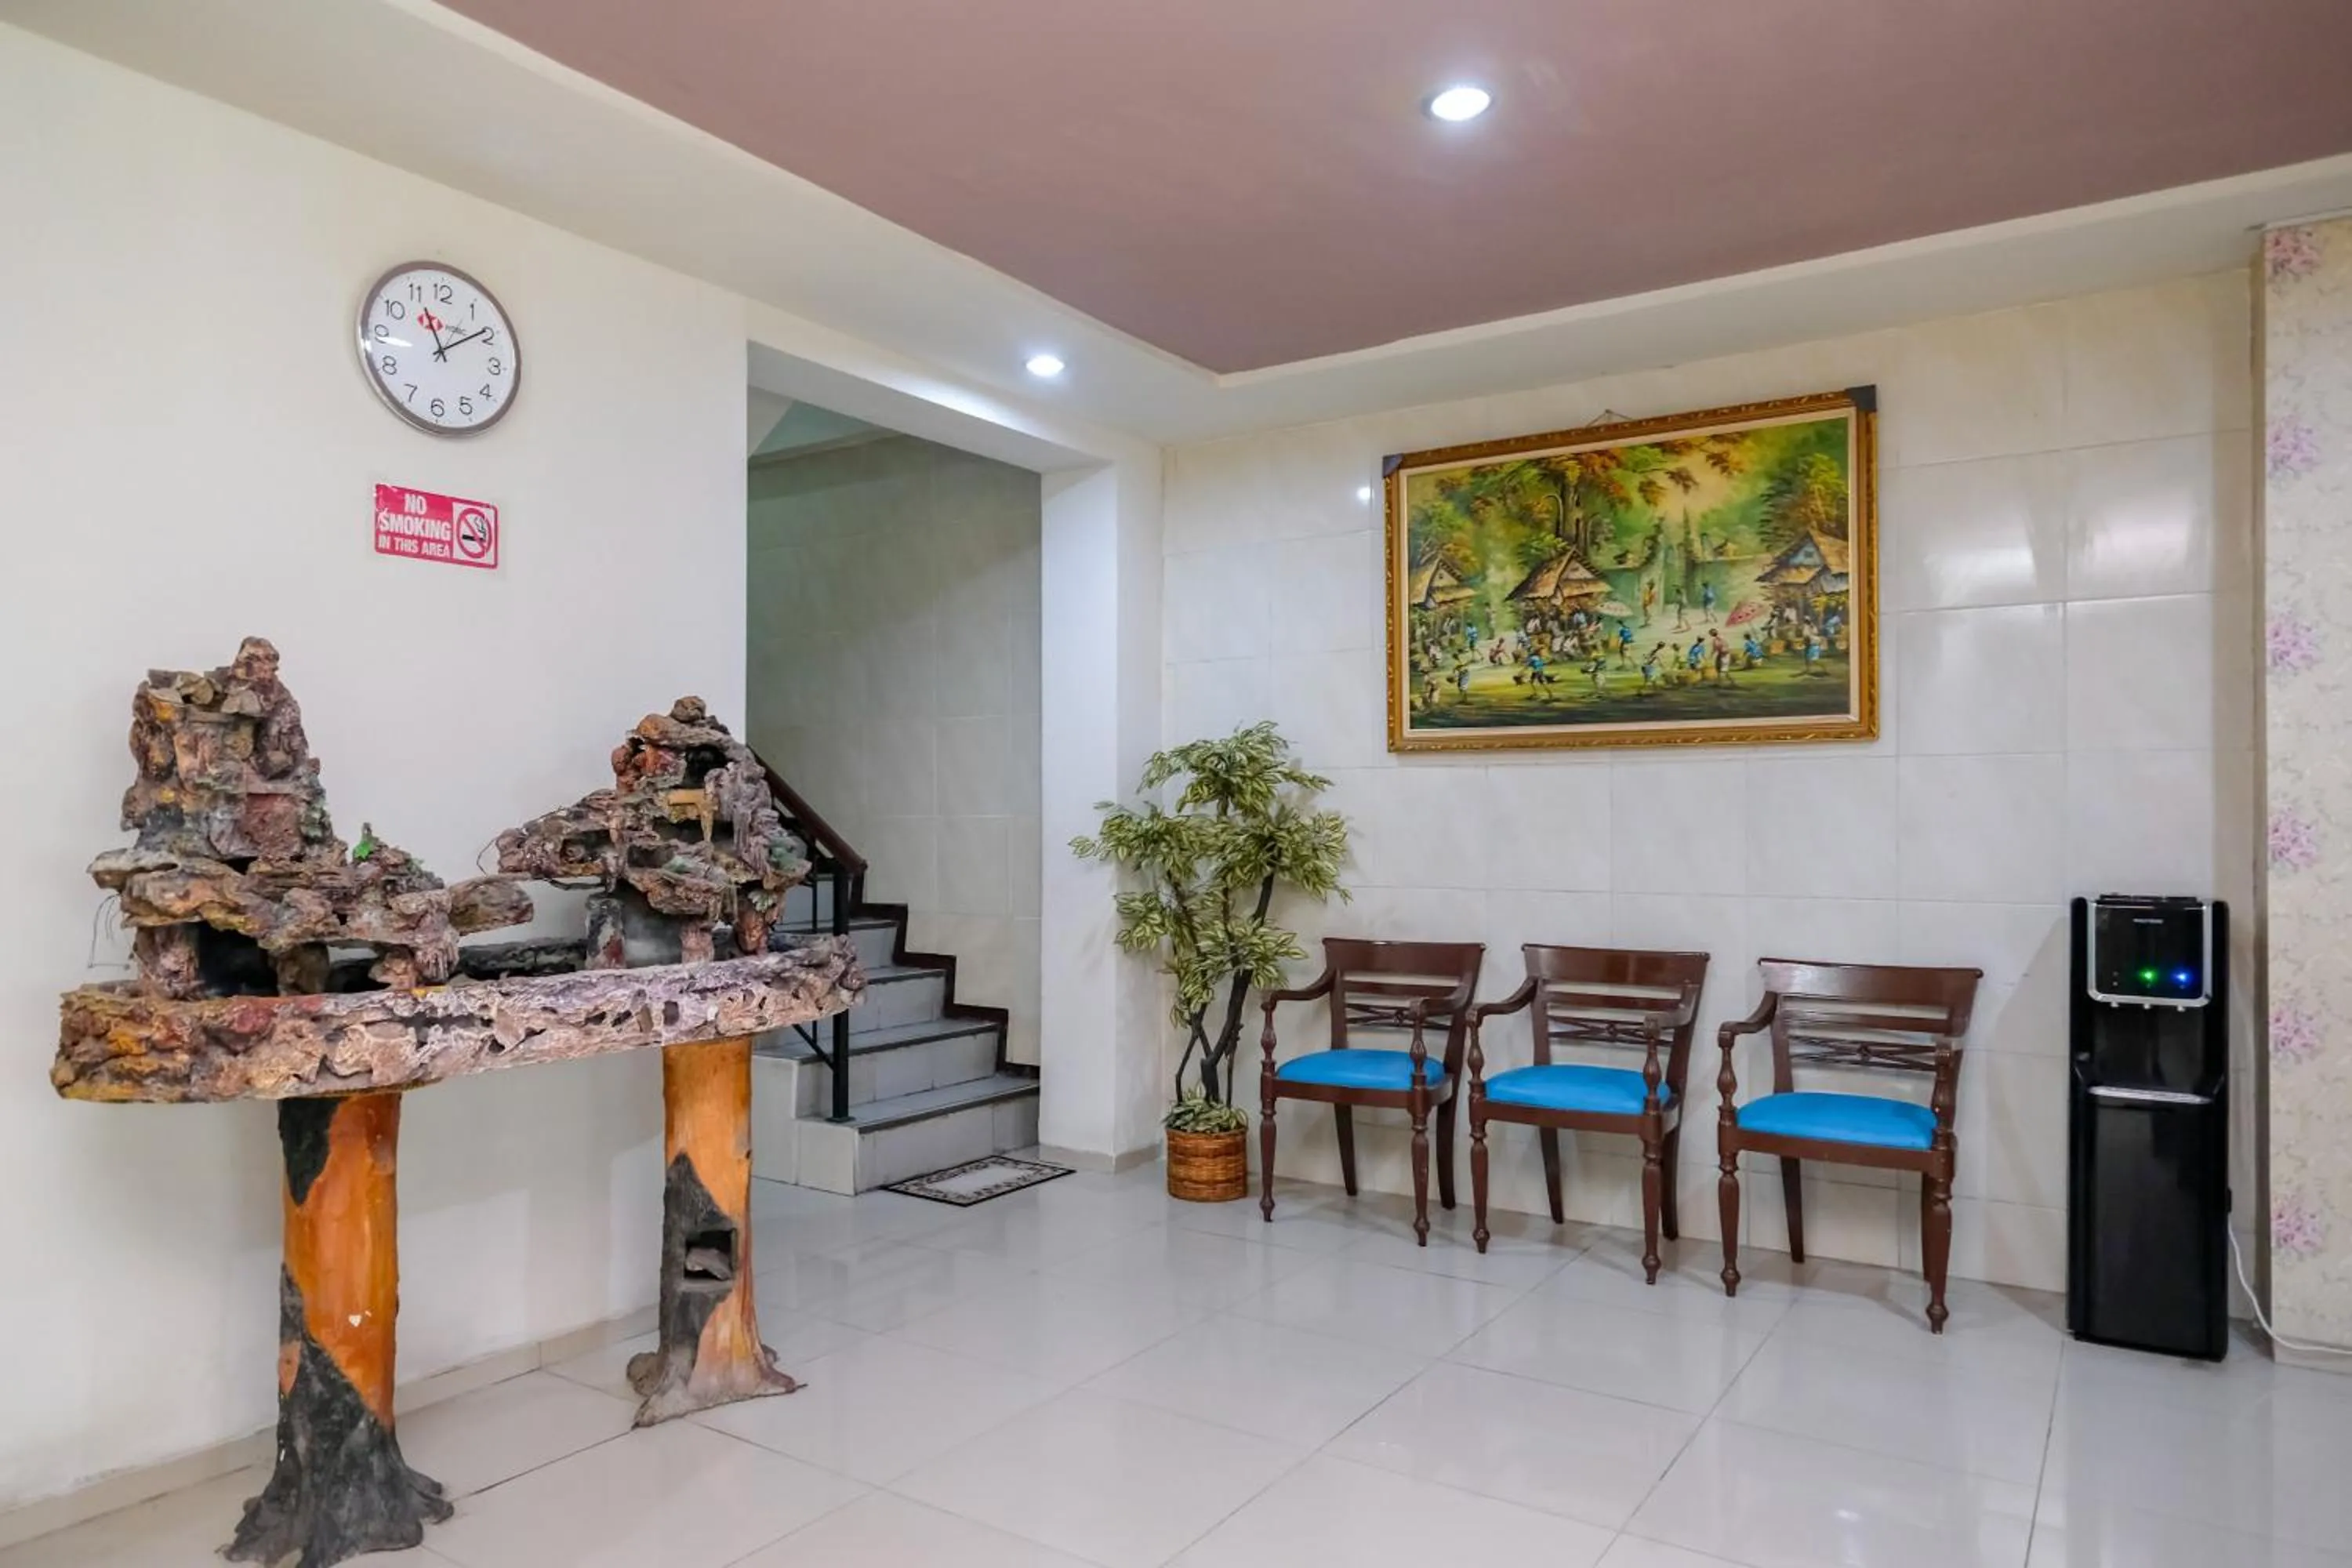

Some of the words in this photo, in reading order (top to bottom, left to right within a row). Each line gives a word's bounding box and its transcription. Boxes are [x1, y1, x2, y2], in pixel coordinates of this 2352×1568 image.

[409, 283, 421, 303] 11
[434, 283, 453, 304] 12
[384, 299, 405, 320] 10
[470, 303, 475, 321] 1
[374, 324, 390, 343] 9
[481, 326, 495, 346] 2
[382, 355, 397, 375] 8
[488, 357, 501, 376] 3
[404, 383, 418, 402] 7
[479, 383, 492, 401] 4
[430, 398, 445, 417] 6
[459, 396, 473, 416] 5
[404, 493, 427, 515] NO
[378, 511, 452, 541] SMOKING
[378, 534, 391, 549] IN
[394, 537, 418, 553] THIS
[421, 541, 451, 557] AREA
